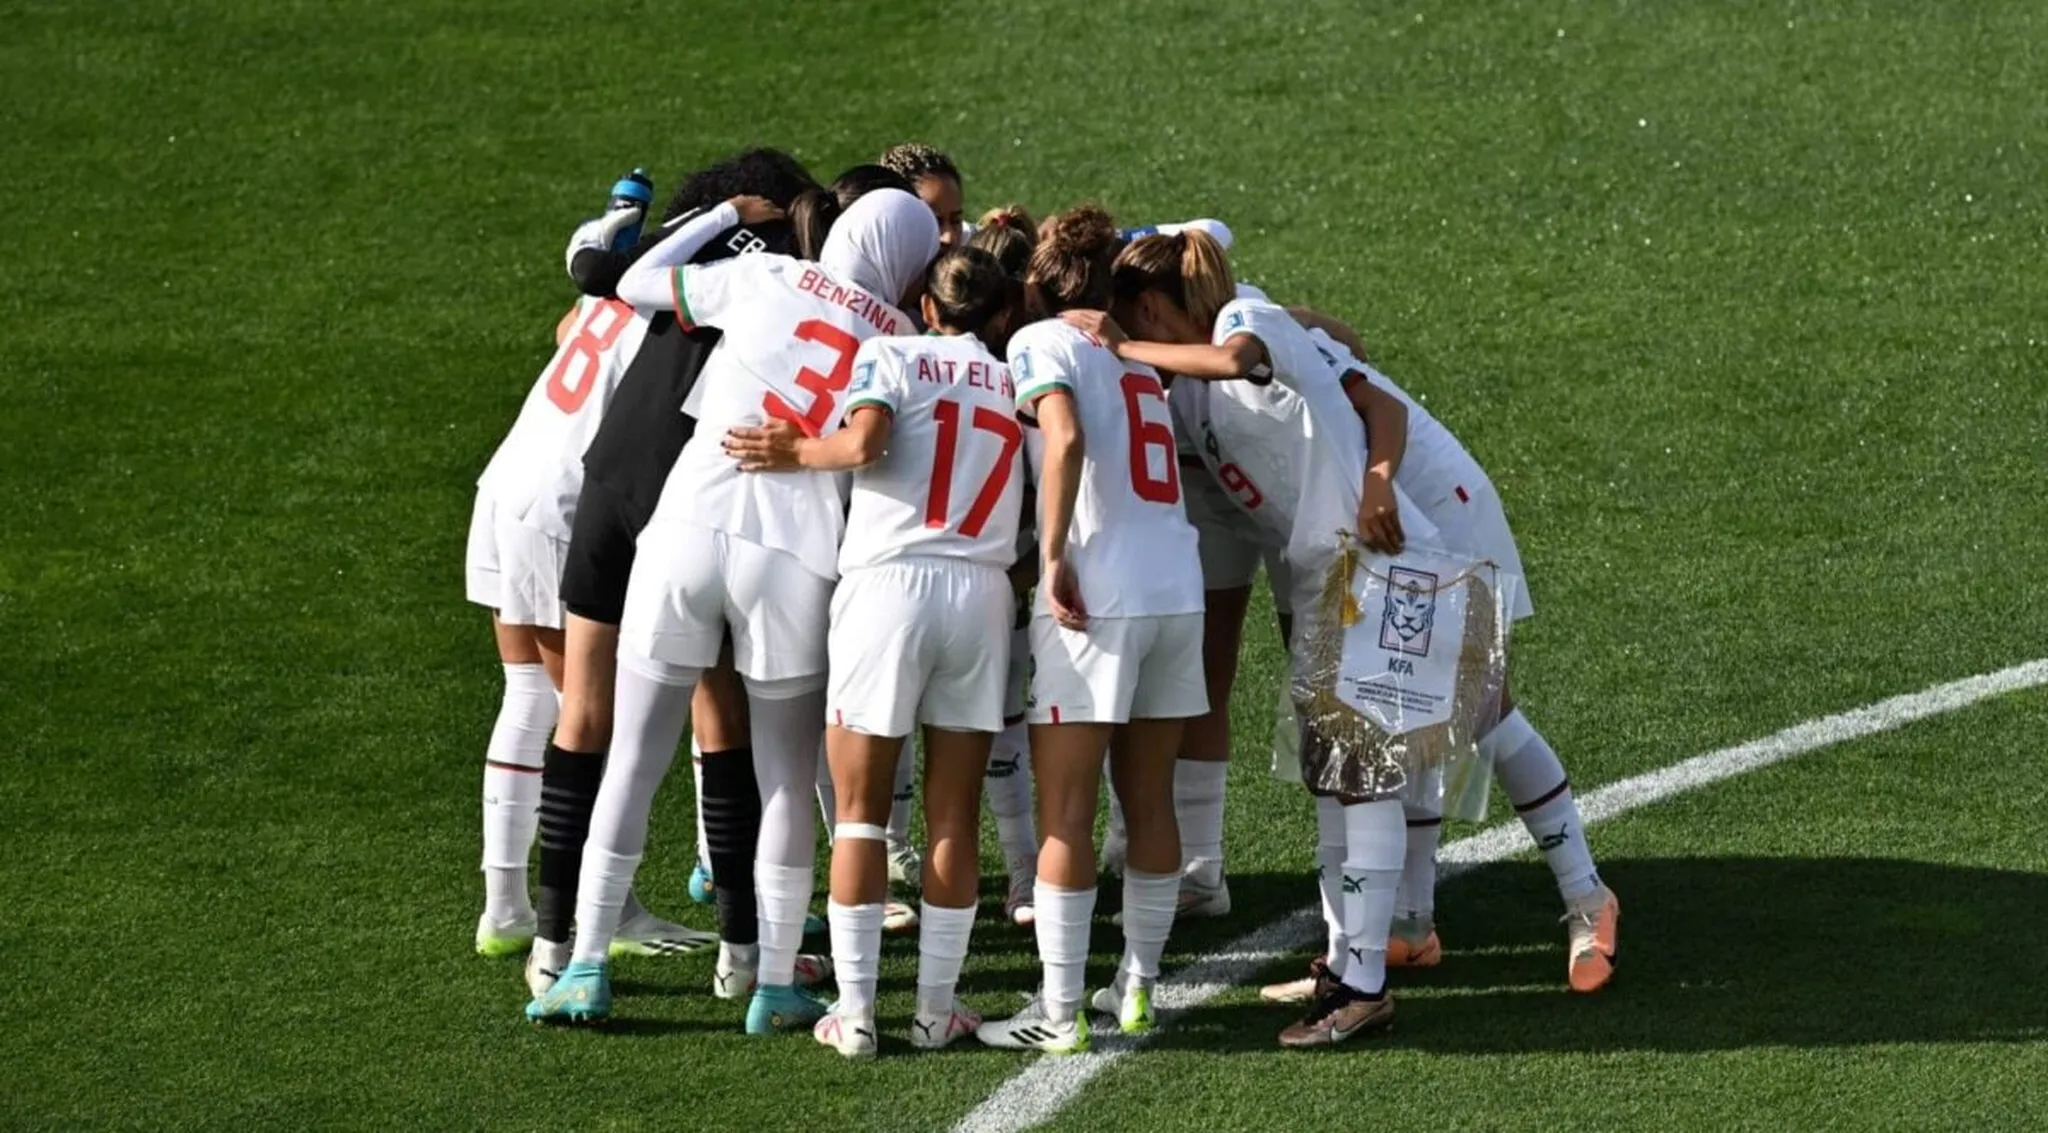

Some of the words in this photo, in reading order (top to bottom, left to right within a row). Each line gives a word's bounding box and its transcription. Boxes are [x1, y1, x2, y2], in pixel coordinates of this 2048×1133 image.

[798, 269, 897, 336] BENZINA
[546, 298, 635, 414] 8
[762, 319, 860, 438] 3
[918, 358, 957, 385] AIT
[968, 361, 995, 391] EL
[925, 398, 1023, 539] 17
[1119, 371, 1180, 505] 6
[1219, 463, 1264, 510] 9
[1388, 657, 1414, 676] KFA
